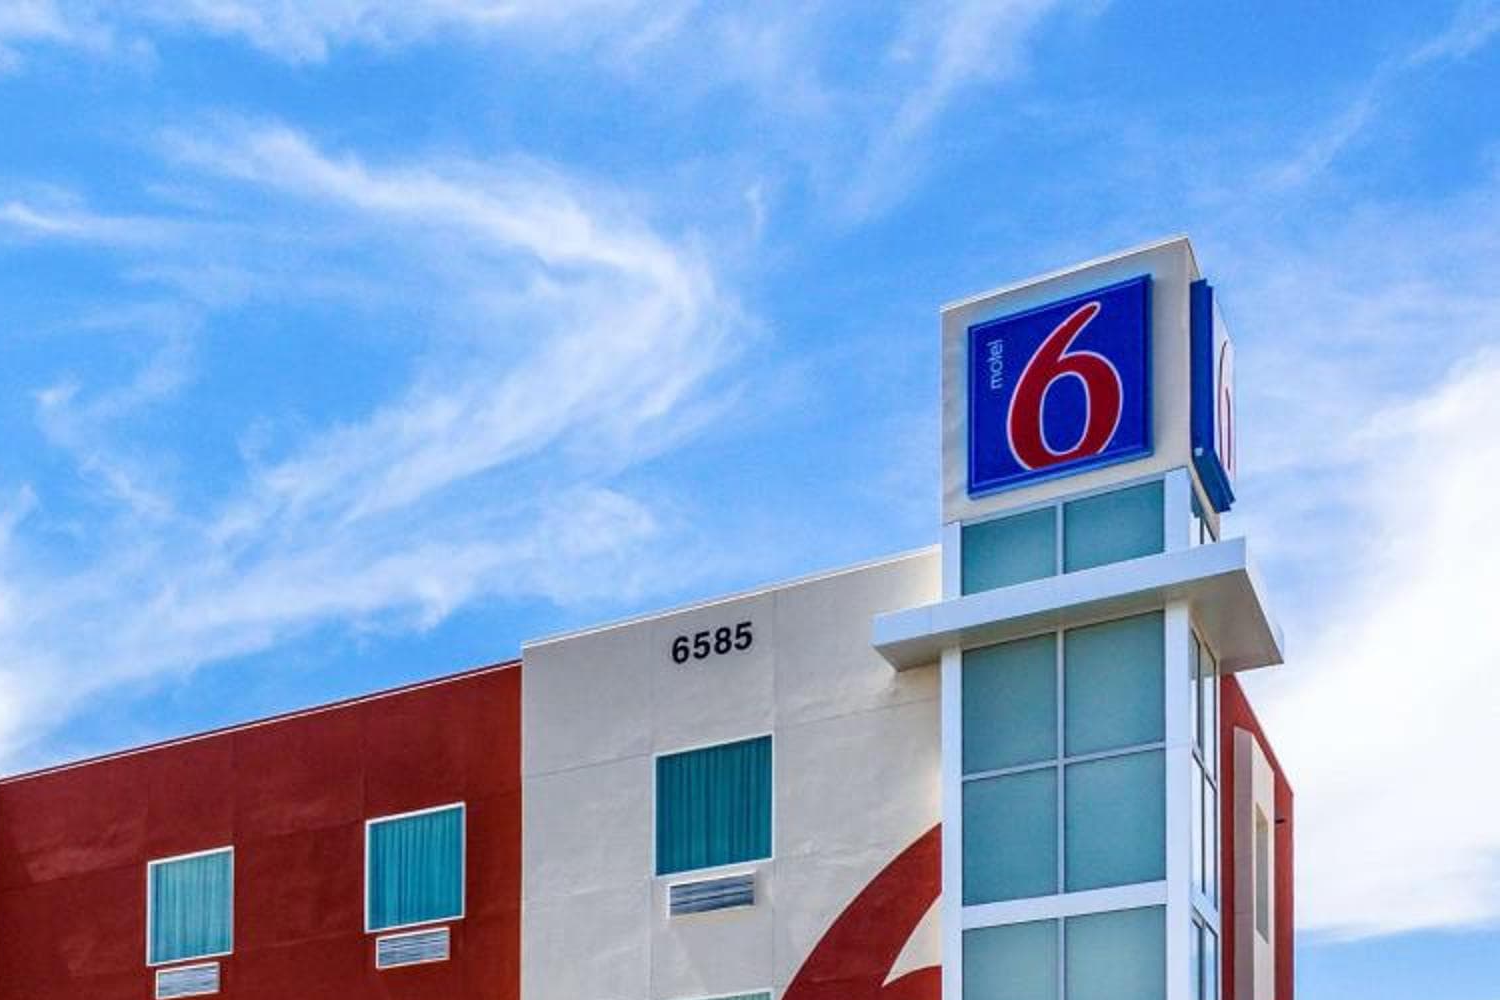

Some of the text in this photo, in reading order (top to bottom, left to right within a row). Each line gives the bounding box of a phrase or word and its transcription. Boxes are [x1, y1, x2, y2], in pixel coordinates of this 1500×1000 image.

[986, 339, 1003, 389] motel
[1007, 301, 1123, 471] 6
[671, 620, 753, 665] 6585
